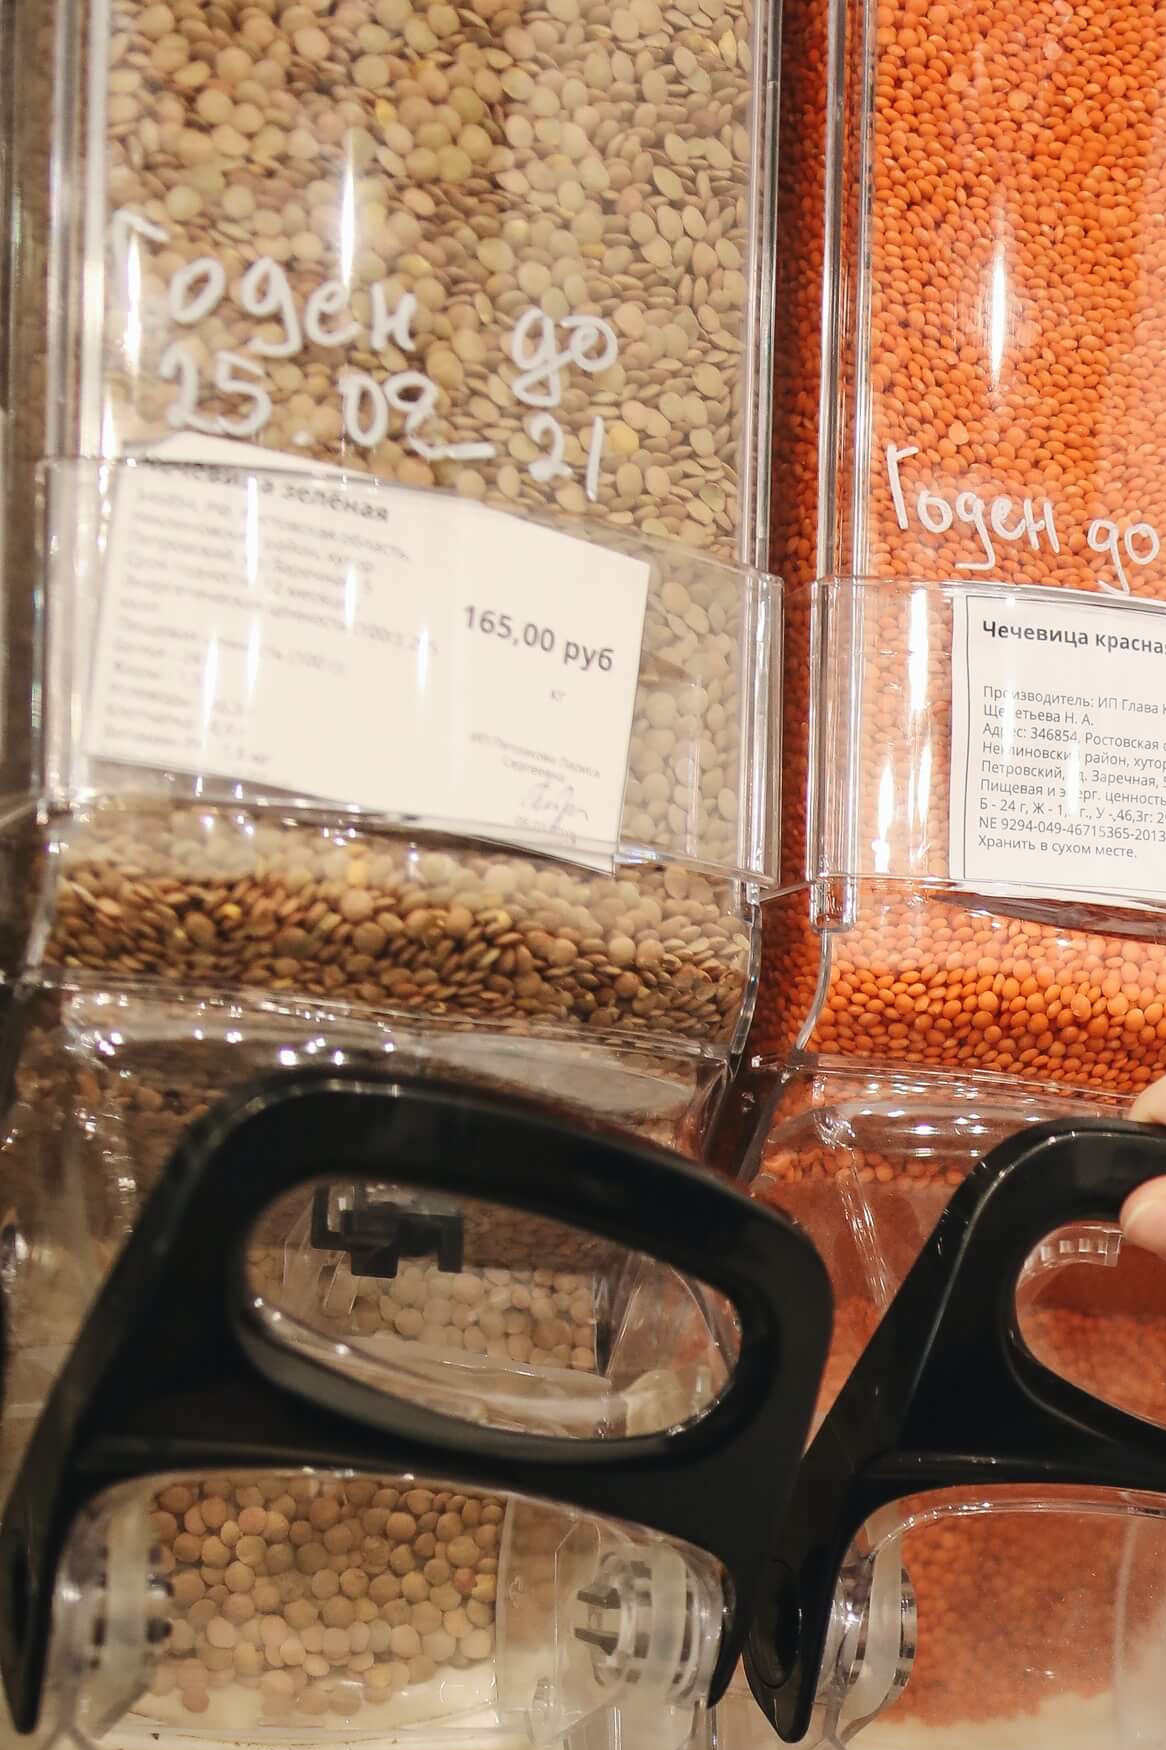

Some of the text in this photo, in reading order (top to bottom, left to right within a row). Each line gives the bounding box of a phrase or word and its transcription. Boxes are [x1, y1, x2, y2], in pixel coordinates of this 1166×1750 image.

[283, 484, 389, 521] зелёная
[464, 604, 556, 653] 165,00
[563, 640, 615, 671] руб
[983, 620, 1089, 647] Чечевица
[983, 704, 1095, 727] Щеетьева Н. А.
[1098, 696, 1118, 711] ИП
[1122, 699, 1159, 714] Глава
[982, 722, 1027, 739] Адс:
[1085, 732, 1159, 751] Ростовская
[982, 741, 1079, 761] Нелиновски
[1085, 751, 1130, 769] район,
[981, 760, 1066, 781] Петровский,
[1091, 770, 1159, 789] Заречная,
[980, 778, 1043, 796] Пищевая
[1047, 787, 1056, 797] и
[1059, 788, 1101, 802] эрг.
[979, 798, 988, 810] Б
[1000, 799, 1016, 812] 24
[1020, 803, 1029, 815] г,
[1032, 802, 1045, 814] Ж
[1096, 807, 1105, 818] У
[978, 834, 1137, 859] Хранить в сухом месте.
